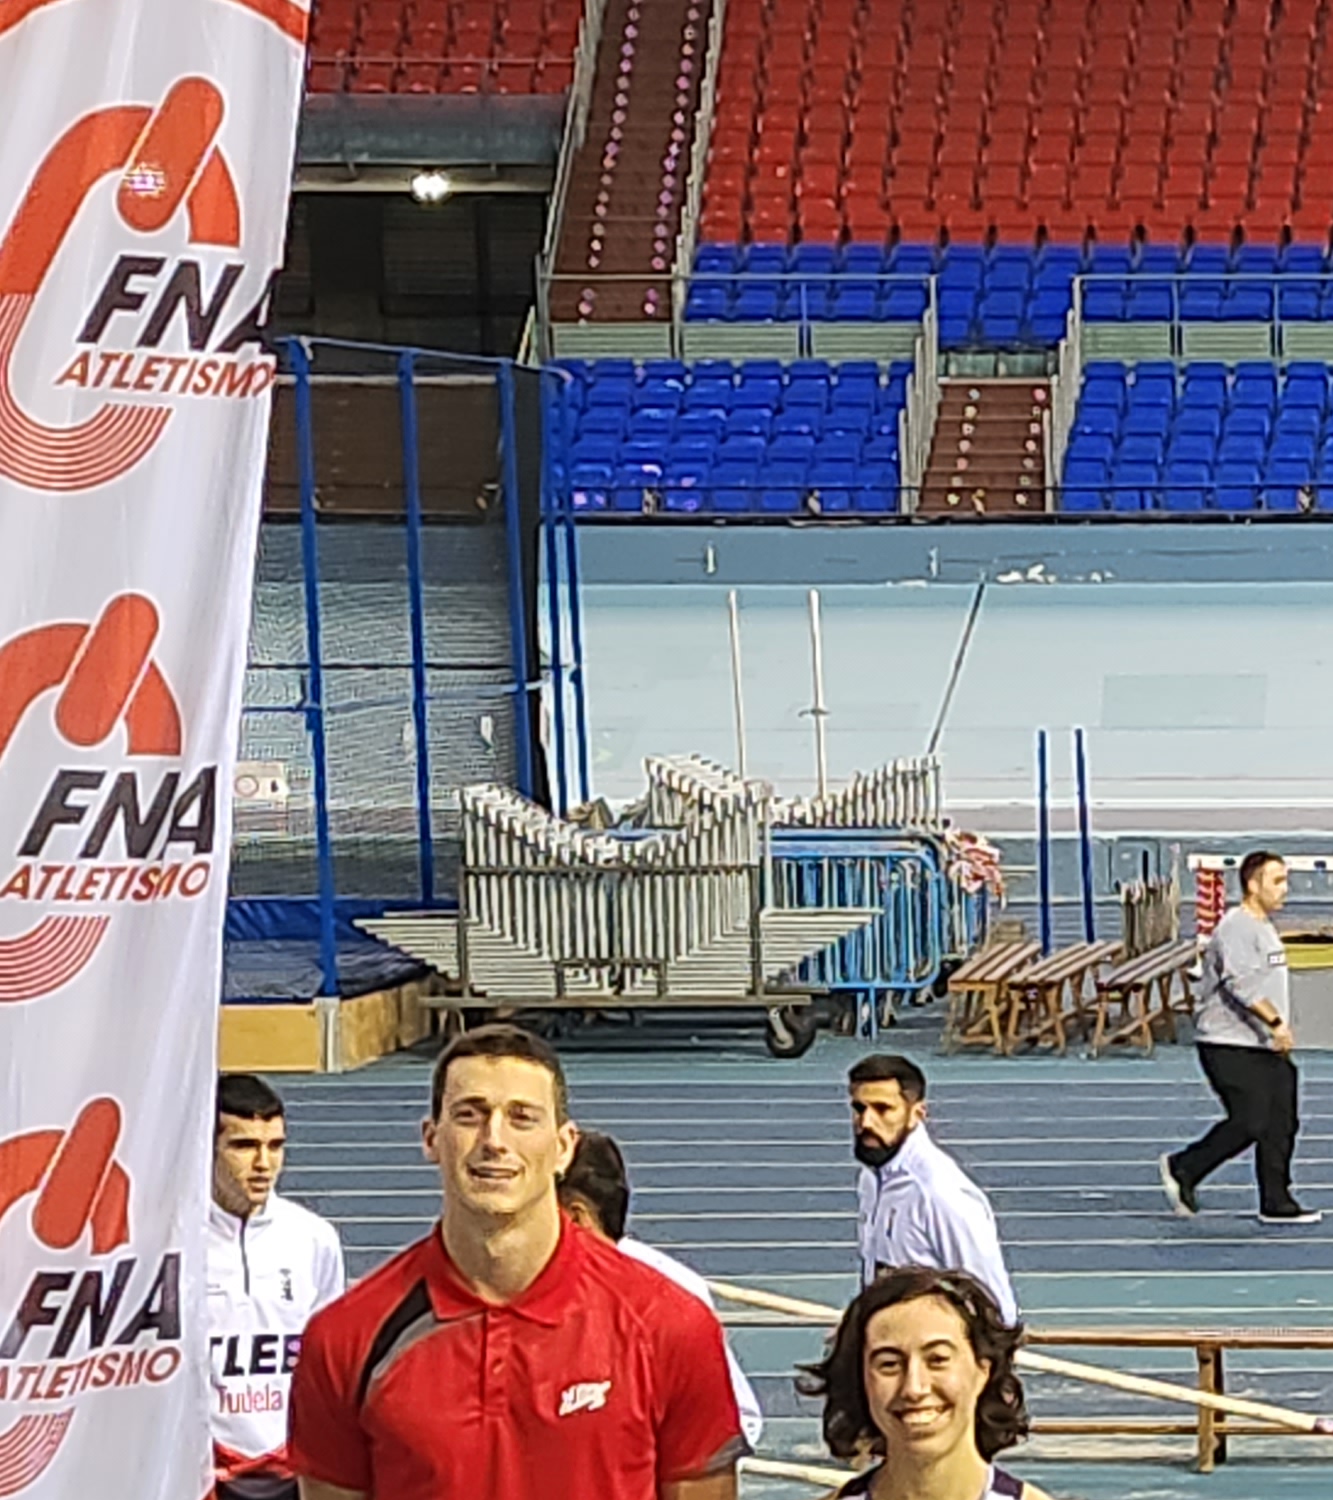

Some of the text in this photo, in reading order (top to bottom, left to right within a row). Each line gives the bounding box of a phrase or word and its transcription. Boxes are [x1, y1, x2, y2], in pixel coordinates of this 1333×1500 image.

[76, 255, 278, 353] FNA
[54, 352, 276, 399] ATLETISMO
[17, 765, 217, 860] FNA
[0, 861, 211, 901] ATLETISMO
[0, 1252, 182, 1360] FNA
[216, 1382, 284, 1413] Tudela
